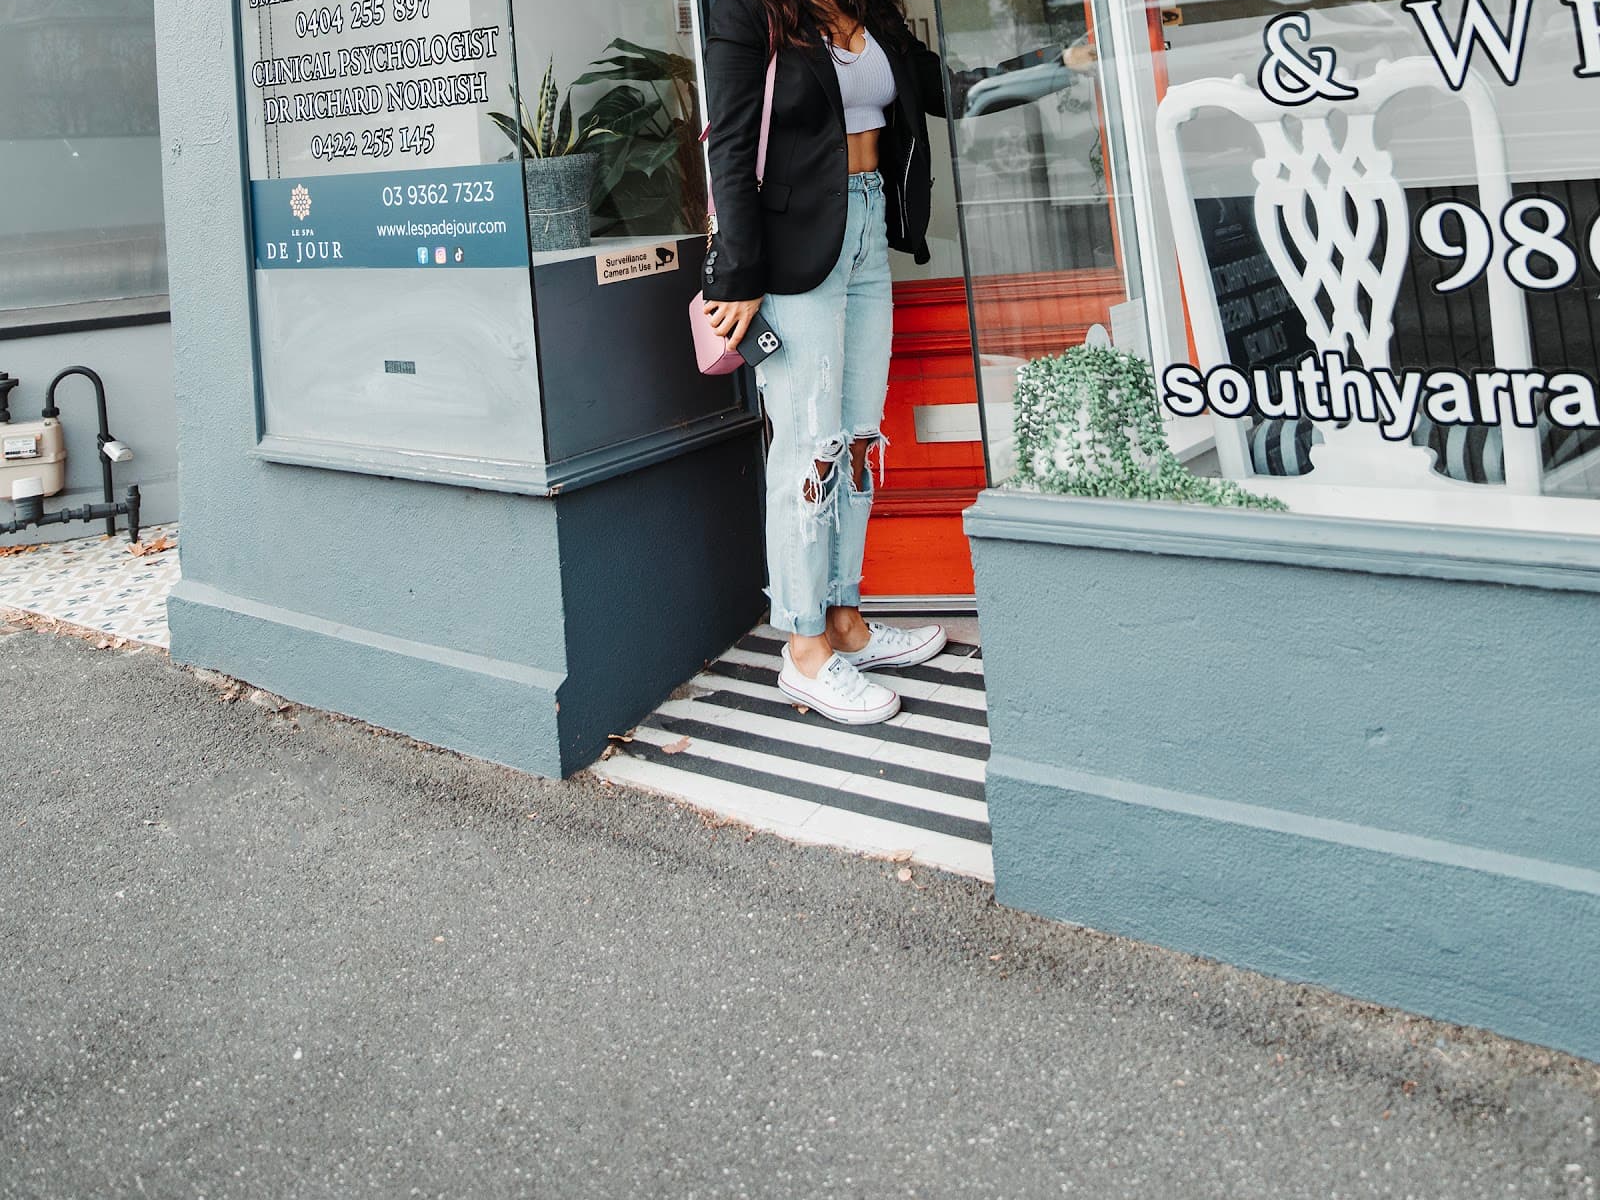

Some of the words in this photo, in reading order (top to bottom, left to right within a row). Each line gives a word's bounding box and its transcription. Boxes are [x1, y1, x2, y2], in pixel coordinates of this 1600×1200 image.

[295, 4, 343, 38] 0404
[251, 50, 337, 87] CLINICAL
[338, 26, 499, 78] PSYCHOLOGIST
[1257, 11, 1359, 106] &
[264, 96, 293, 125] DR
[294, 84, 383, 121] RICHARD
[386, 72, 488, 112] NORRISH
[311, 129, 357, 161] 0422
[361, 127, 394, 157] 255
[398, 124, 435, 155] 145
[382, 186, 403, 207] 03
[407, 183, 448, 206] 9362
[453, 181, 495, 204] 7323
[376, 220, 507, 239] www.lespadejour.com
[267, 242, 288, 259] DE
[297, 241, 343, 263] JOUR
[605, 253, 647, 268] Surveillance
[603, 267, 629, 278] Camera
[630, 265, 637, 273] In
[638, 263, 651, 272] Use
